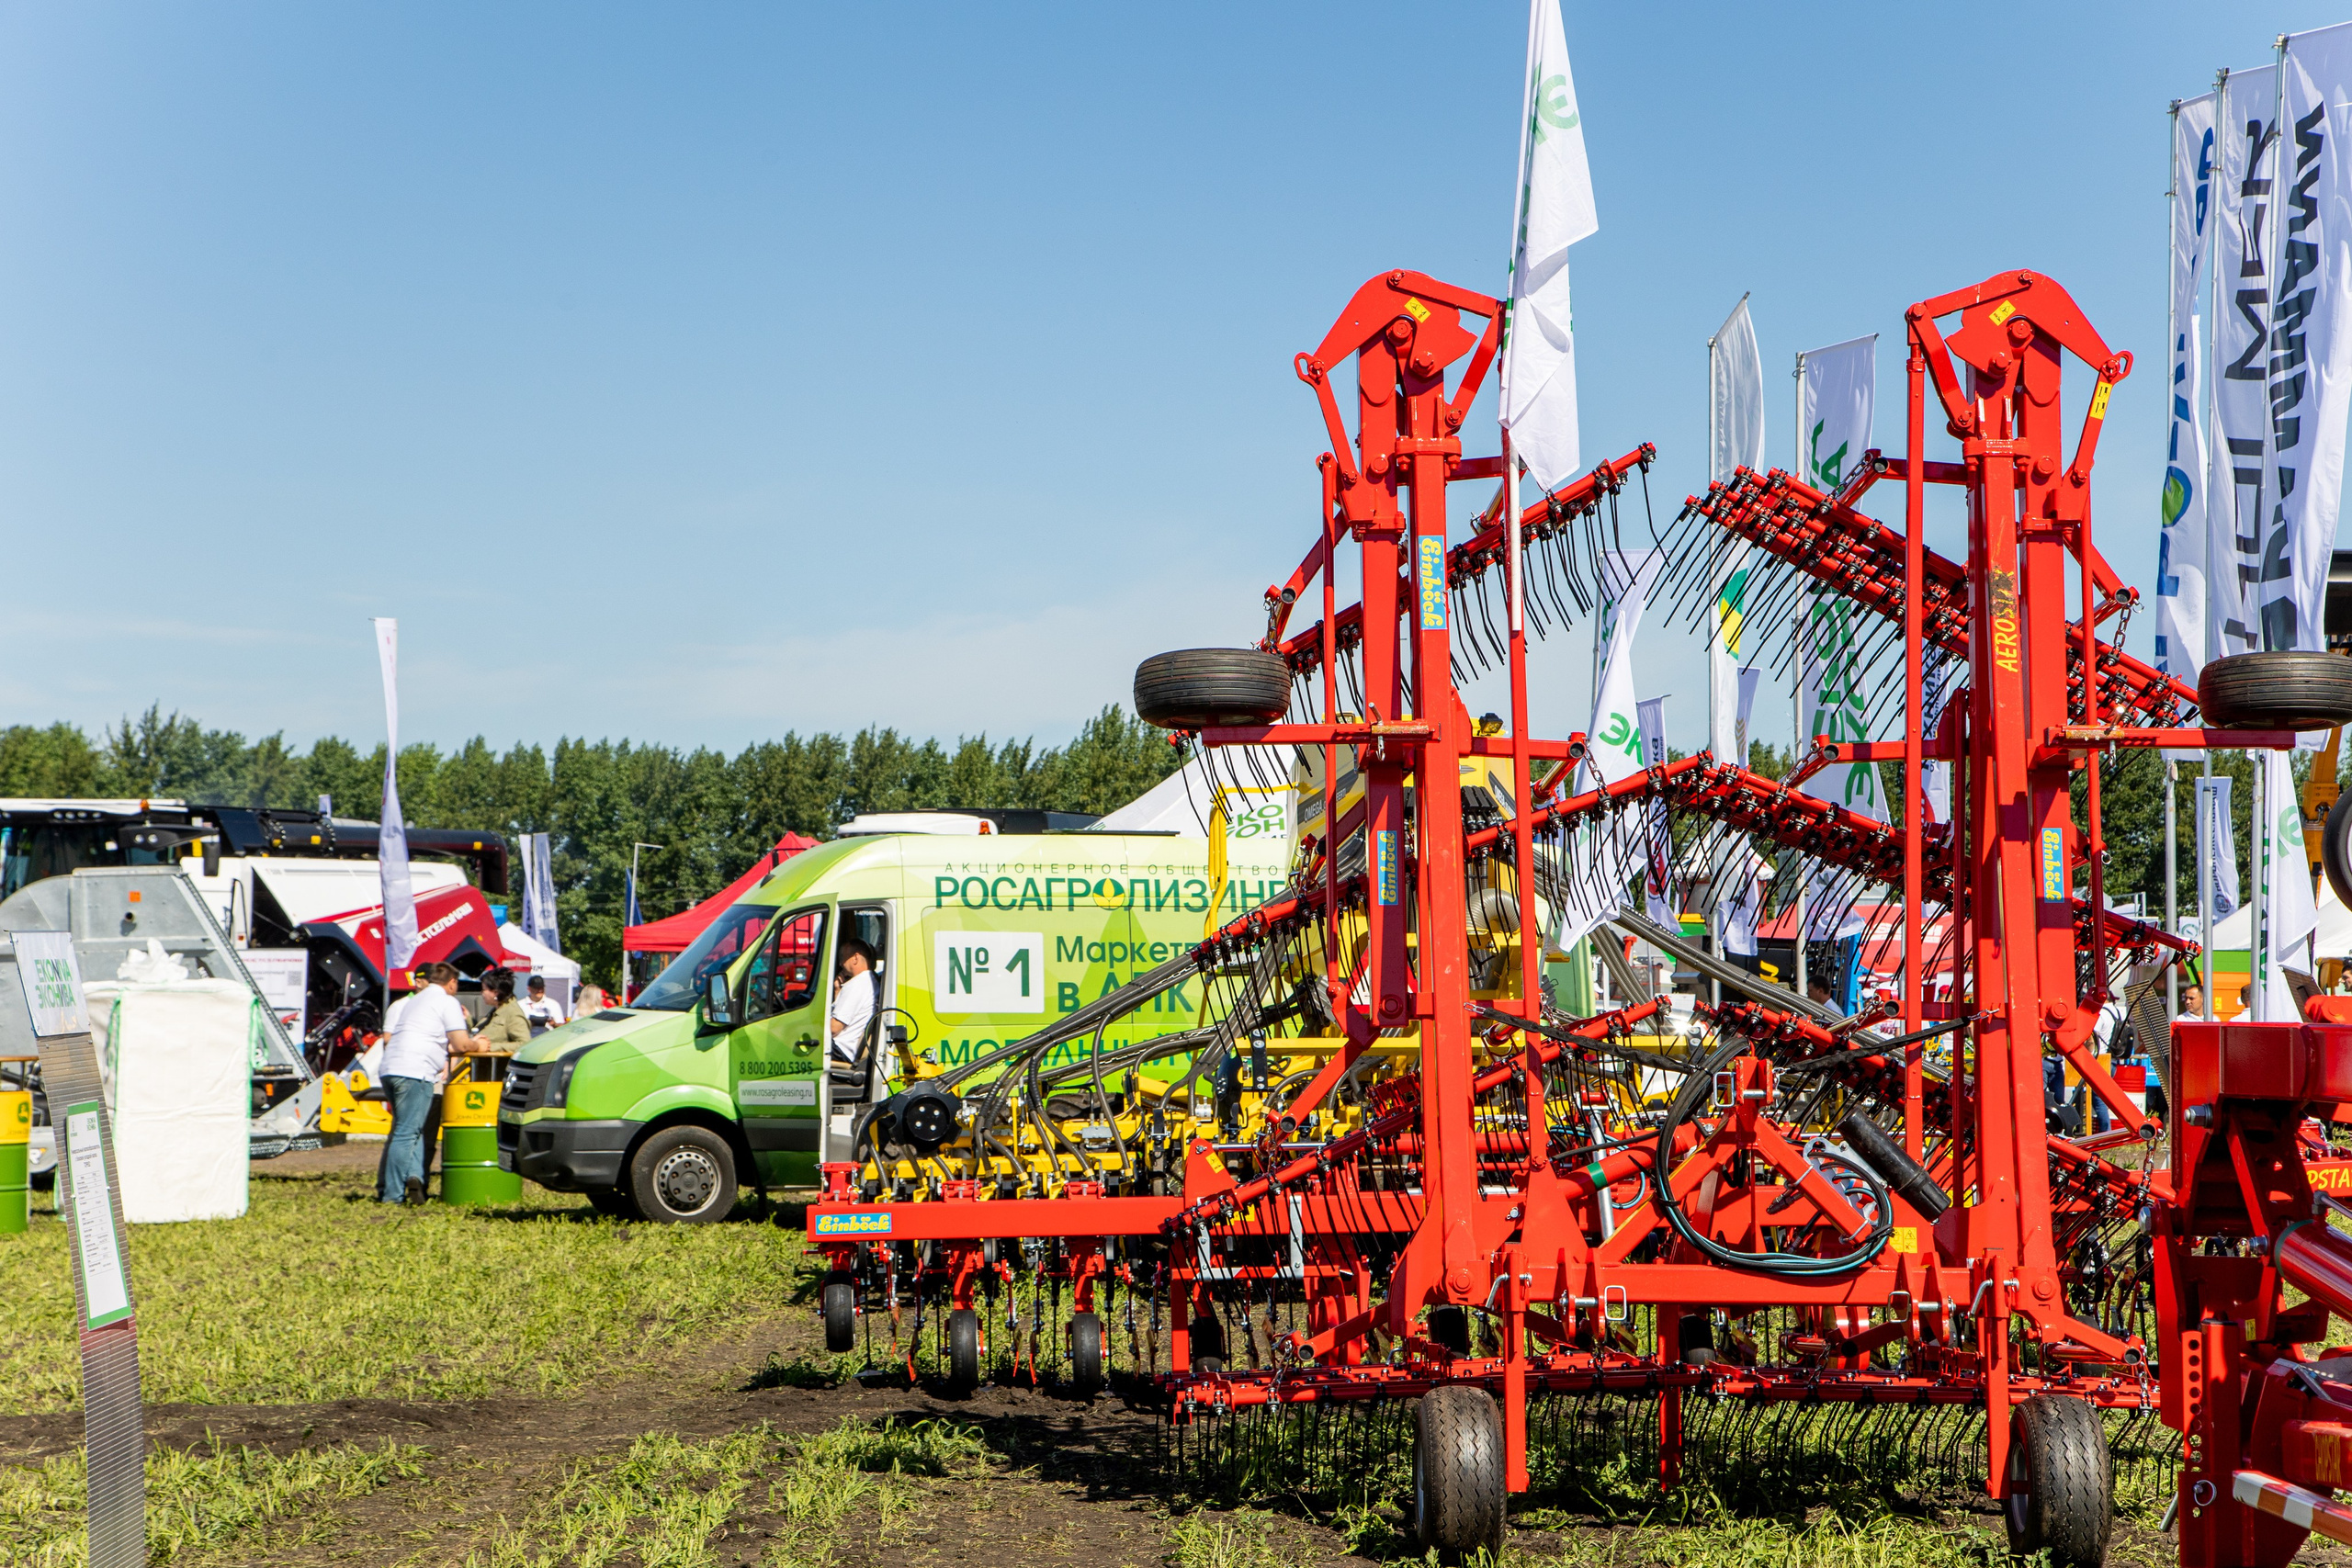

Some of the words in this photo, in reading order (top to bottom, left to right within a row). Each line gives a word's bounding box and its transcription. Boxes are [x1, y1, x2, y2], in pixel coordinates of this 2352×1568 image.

[1419, 537, 1443, 628] Einböck
[944, 863, 1128, 875] АКЦИОНЕРНОЕ
[1148, 863, 1279, 876] ОБЩЕТВО
[1379, 831, 1396, 904] Einböck
[2043, 829, 2063, 901] Einböck
[739, 1061, 745, 1075] 8
[747, 1061, 765, 1075] 800
[767, 1061, 786, 1075] 200
[788, 1061, 813, 1075] 5395
[741, 1087, 812, 1100] www.rosagroleasing.ru
[818, 1214, 890, 1233] Einböck
